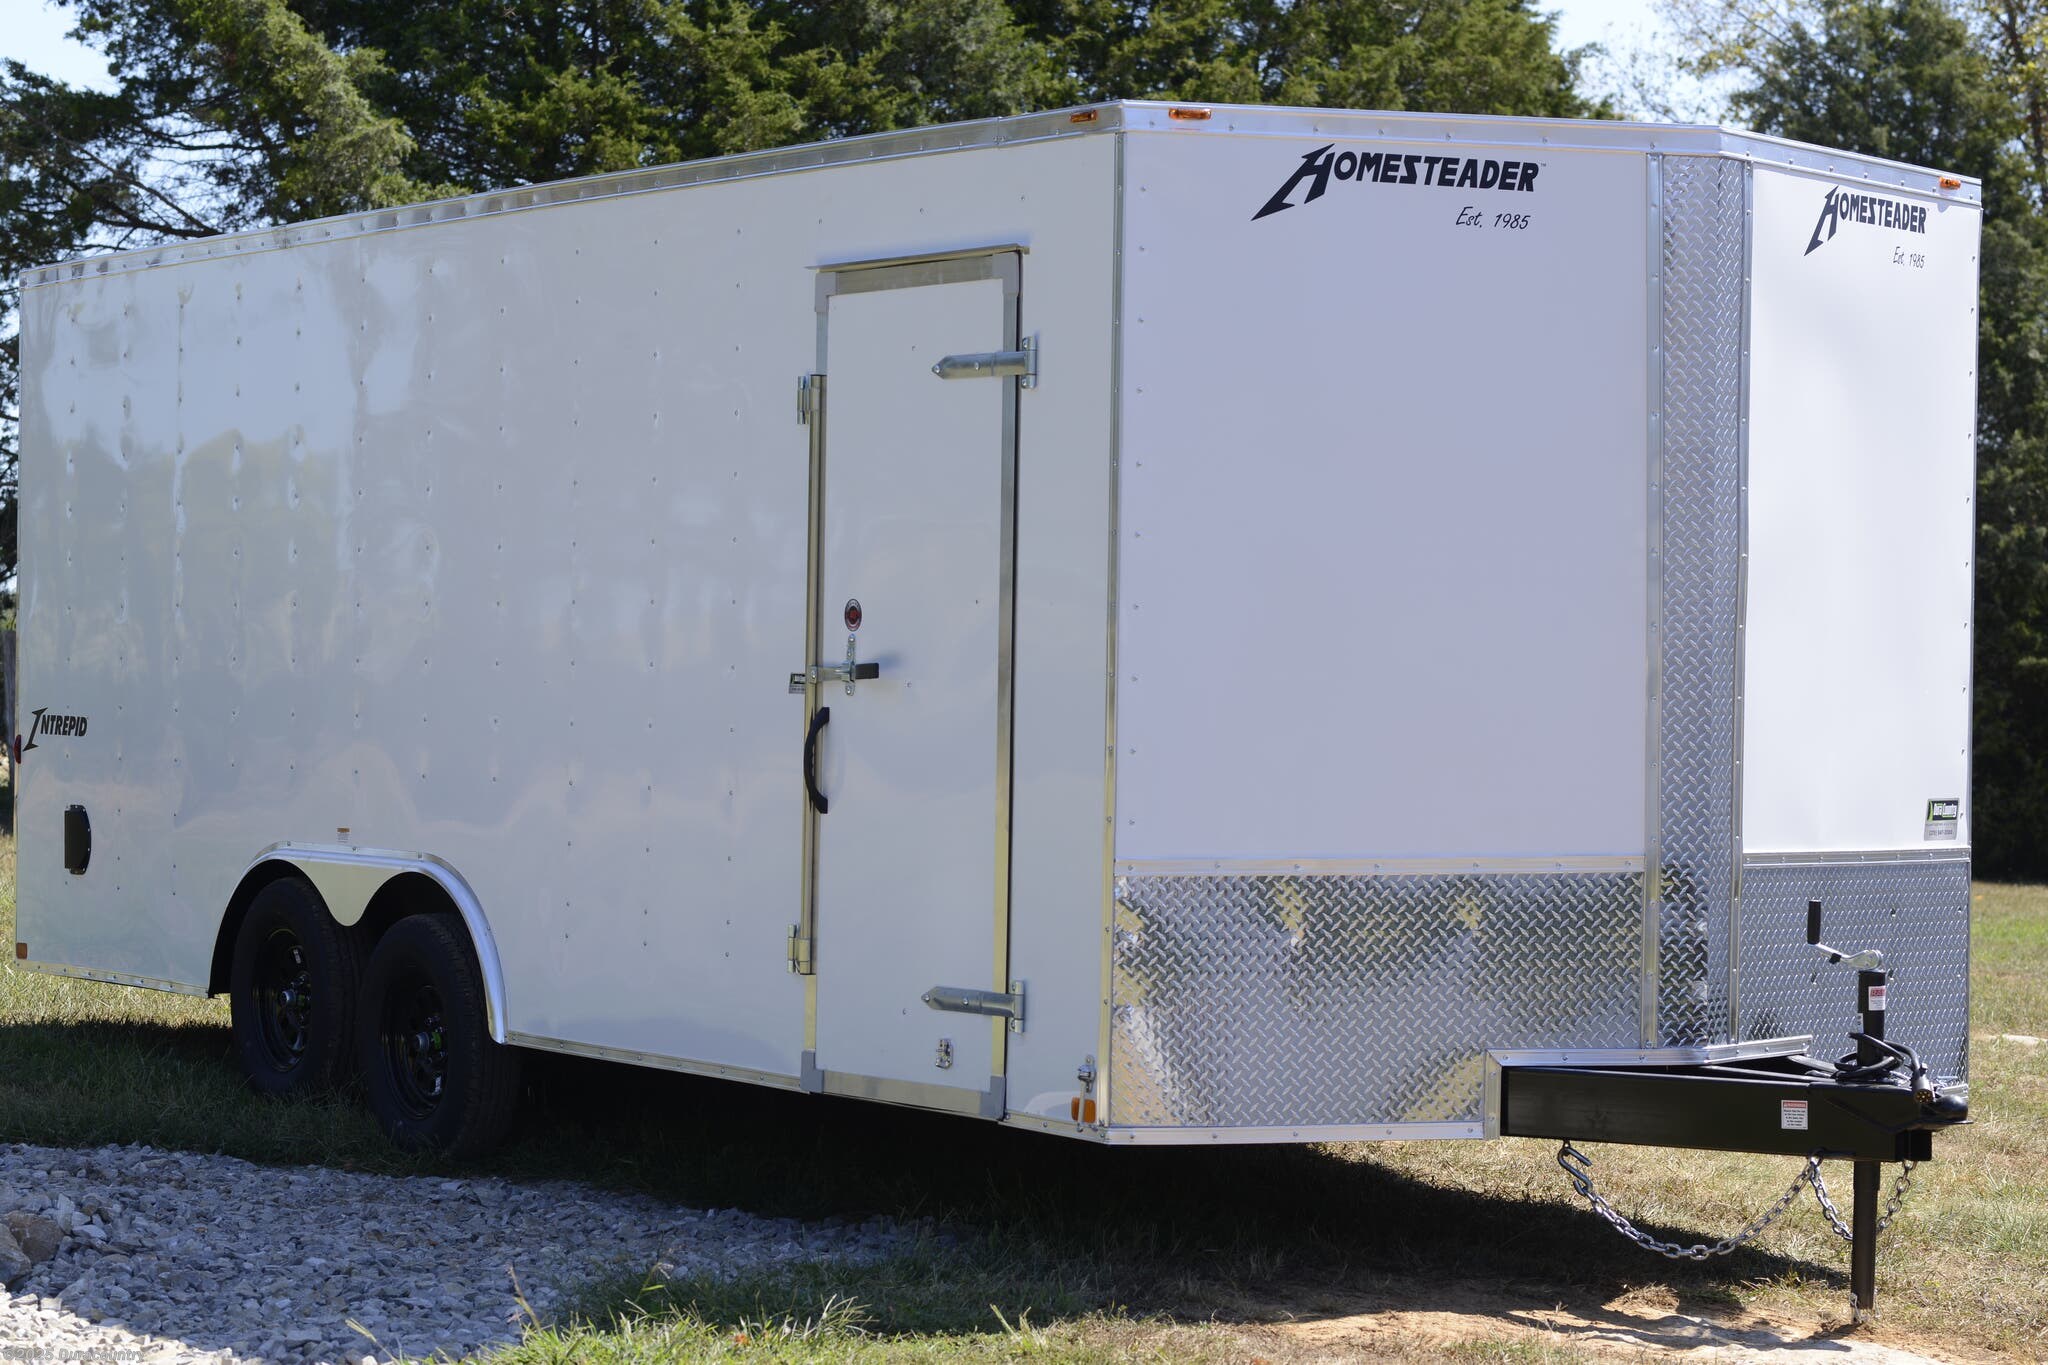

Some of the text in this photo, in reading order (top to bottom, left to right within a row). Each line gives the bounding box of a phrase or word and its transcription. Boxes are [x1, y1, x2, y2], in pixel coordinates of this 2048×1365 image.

[1250, 143, 1540, 221] HOMESTEADER
[1455, 206, 1531, 230] Est. 1985
[1804, 185, 1927, 257] HOMESTEADER
[1909, 252, 1925, 269] 1985
[22, 707, 88, 752] INTREPID
